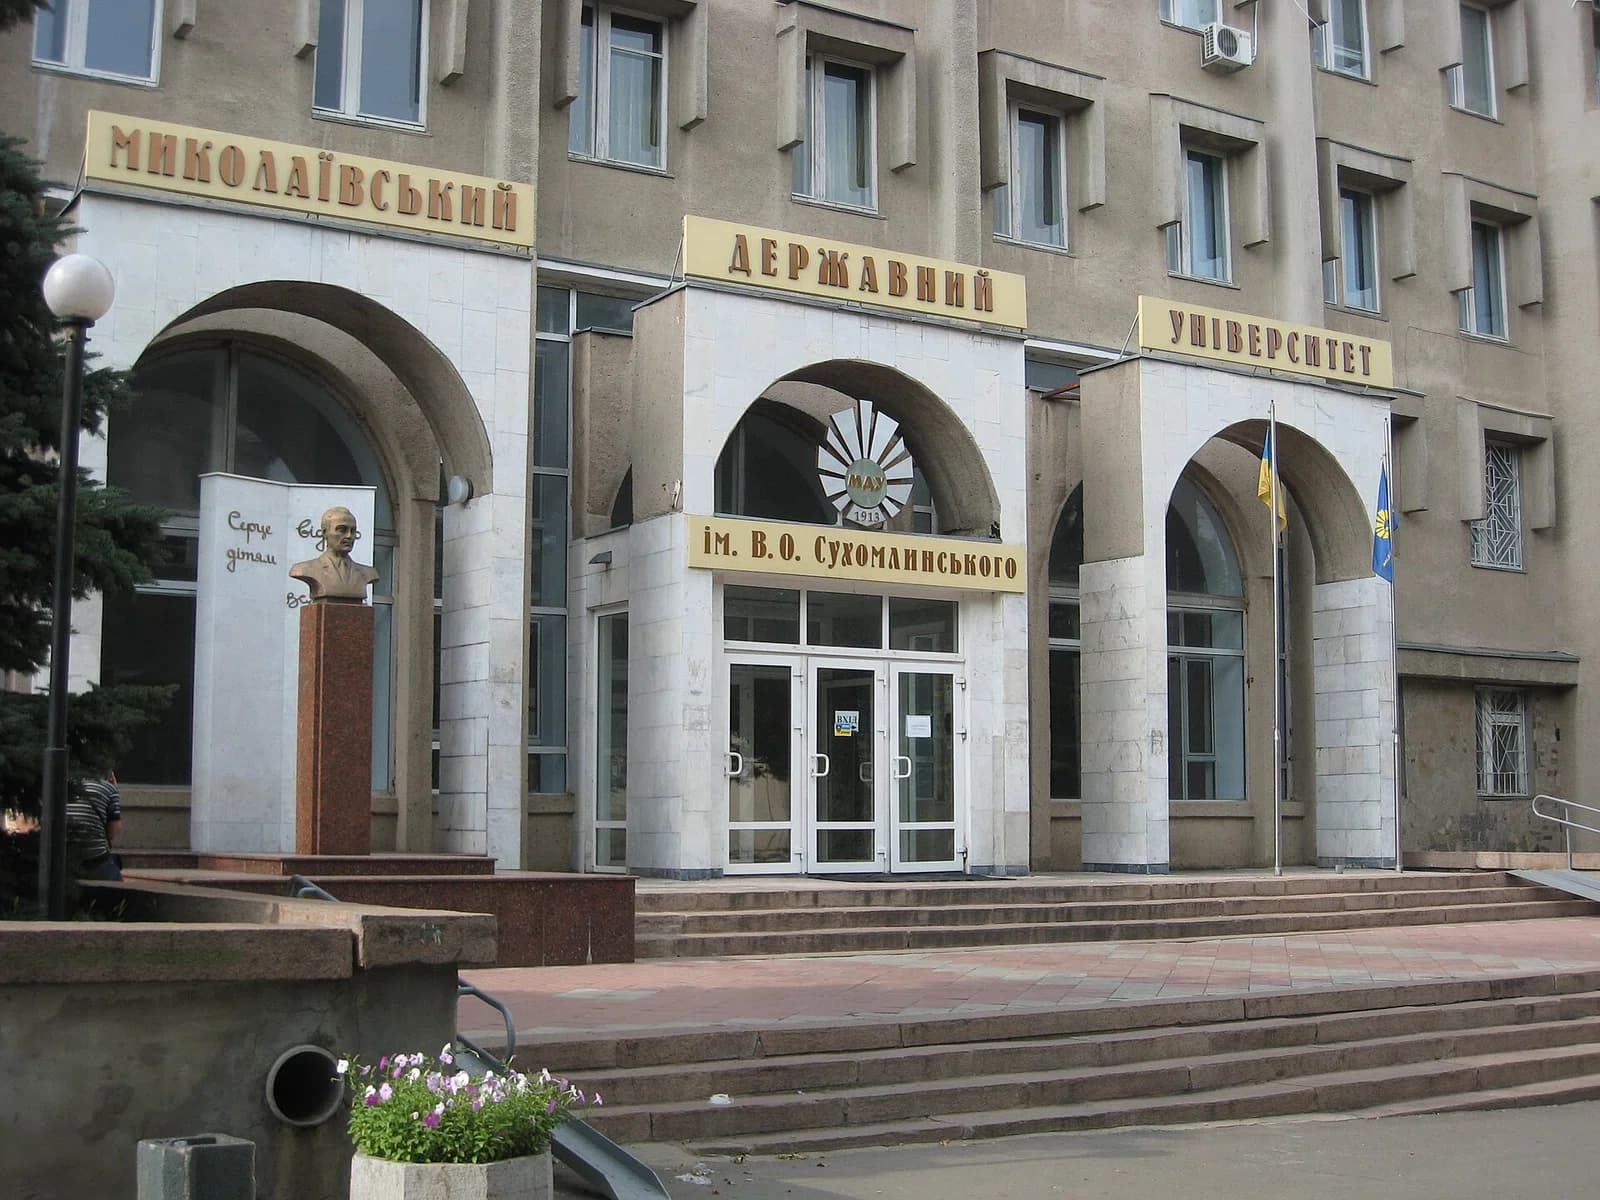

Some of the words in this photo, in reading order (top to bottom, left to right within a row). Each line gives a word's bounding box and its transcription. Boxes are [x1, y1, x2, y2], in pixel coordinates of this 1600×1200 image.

[110, 125, 518, 232] МИКОЛАЇВСЬКИЙ
[729, 233, 993, 312] ДЕРЖАВНИЙ
[1169, 309, 1371, 376] УНІВЕРСИТЕТ
[228, 511, 272, 544] Серце
[296, 519, 362, 552] від
[855, 511, 880, 522] 1913
[226, 547, 277, 573] дітям
[814, 535, 1017, 579] Сухомлинського
